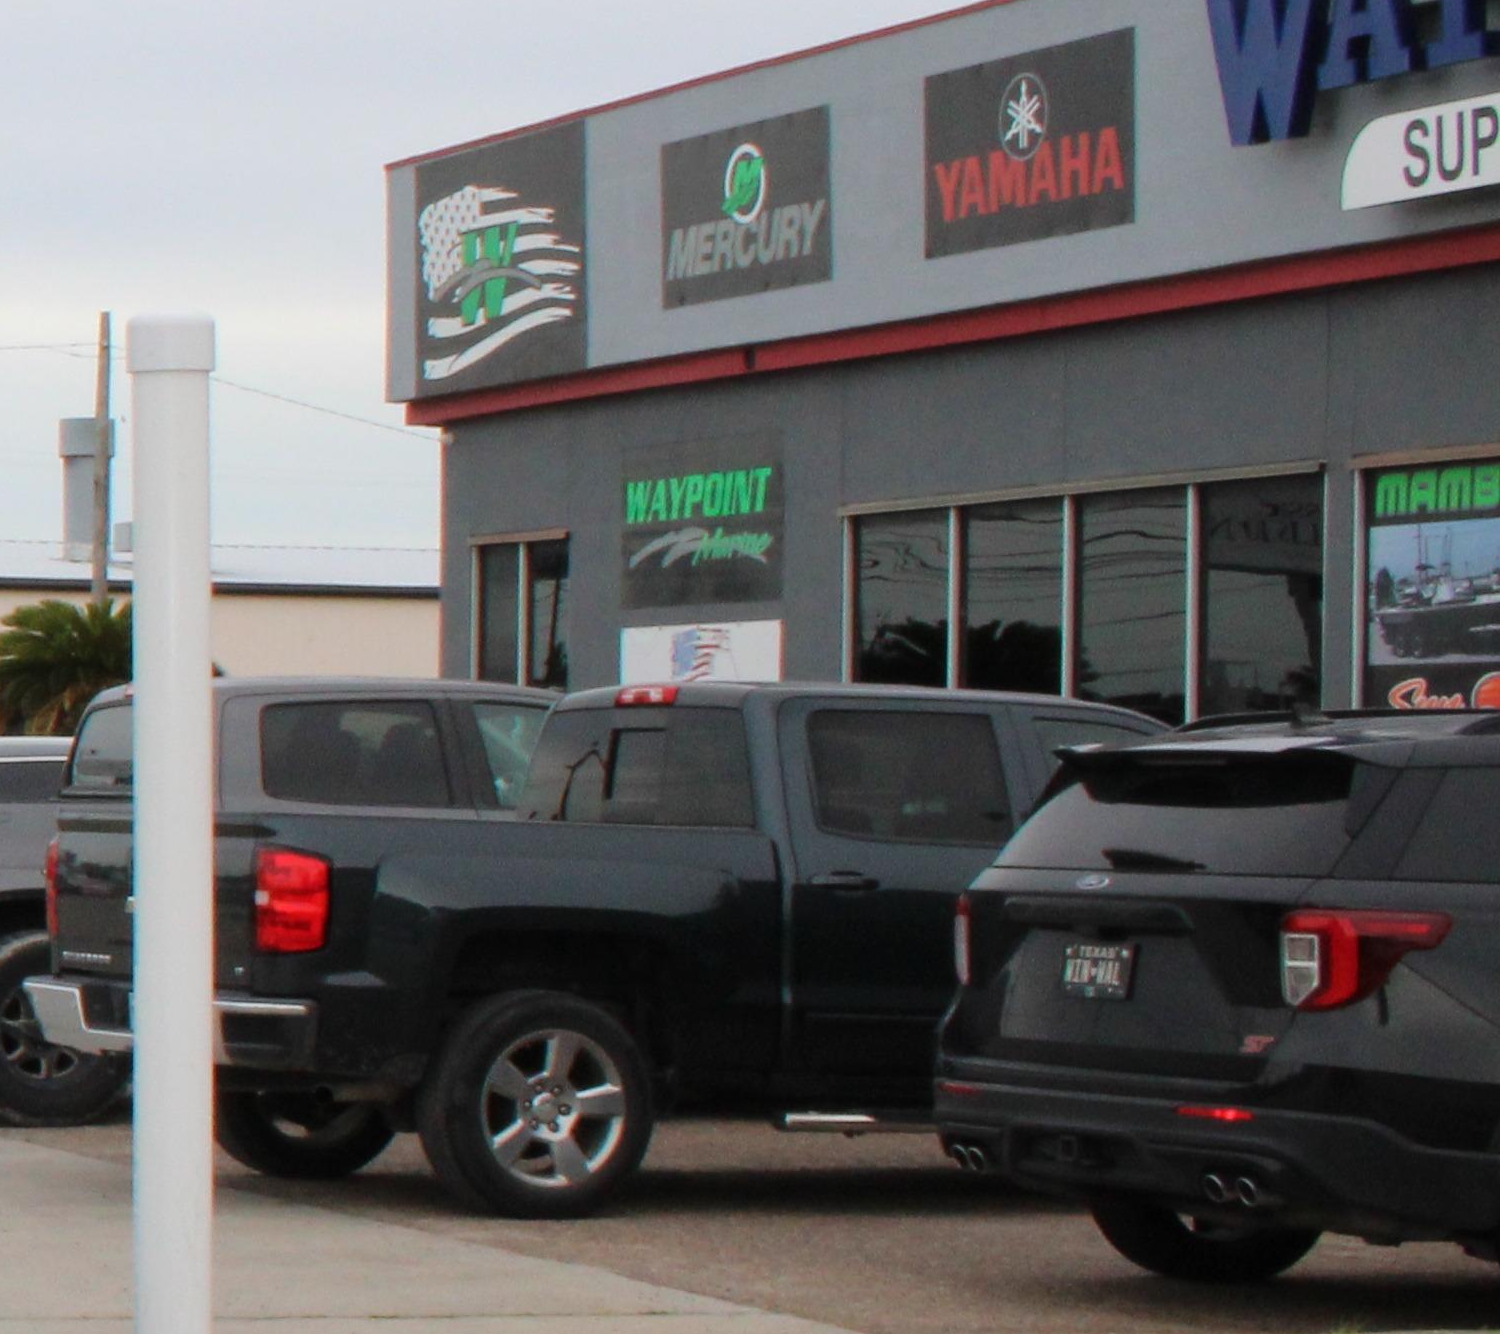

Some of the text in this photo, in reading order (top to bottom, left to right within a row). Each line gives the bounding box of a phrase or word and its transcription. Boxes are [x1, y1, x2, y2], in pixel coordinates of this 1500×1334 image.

[933, 126, 1126, 223] YAMAHA
[1402, 105, 1500, 188] SUP
[667, 199, 827, 280] MERCURY
[626, 467, 773, 524] WAYPOINT
